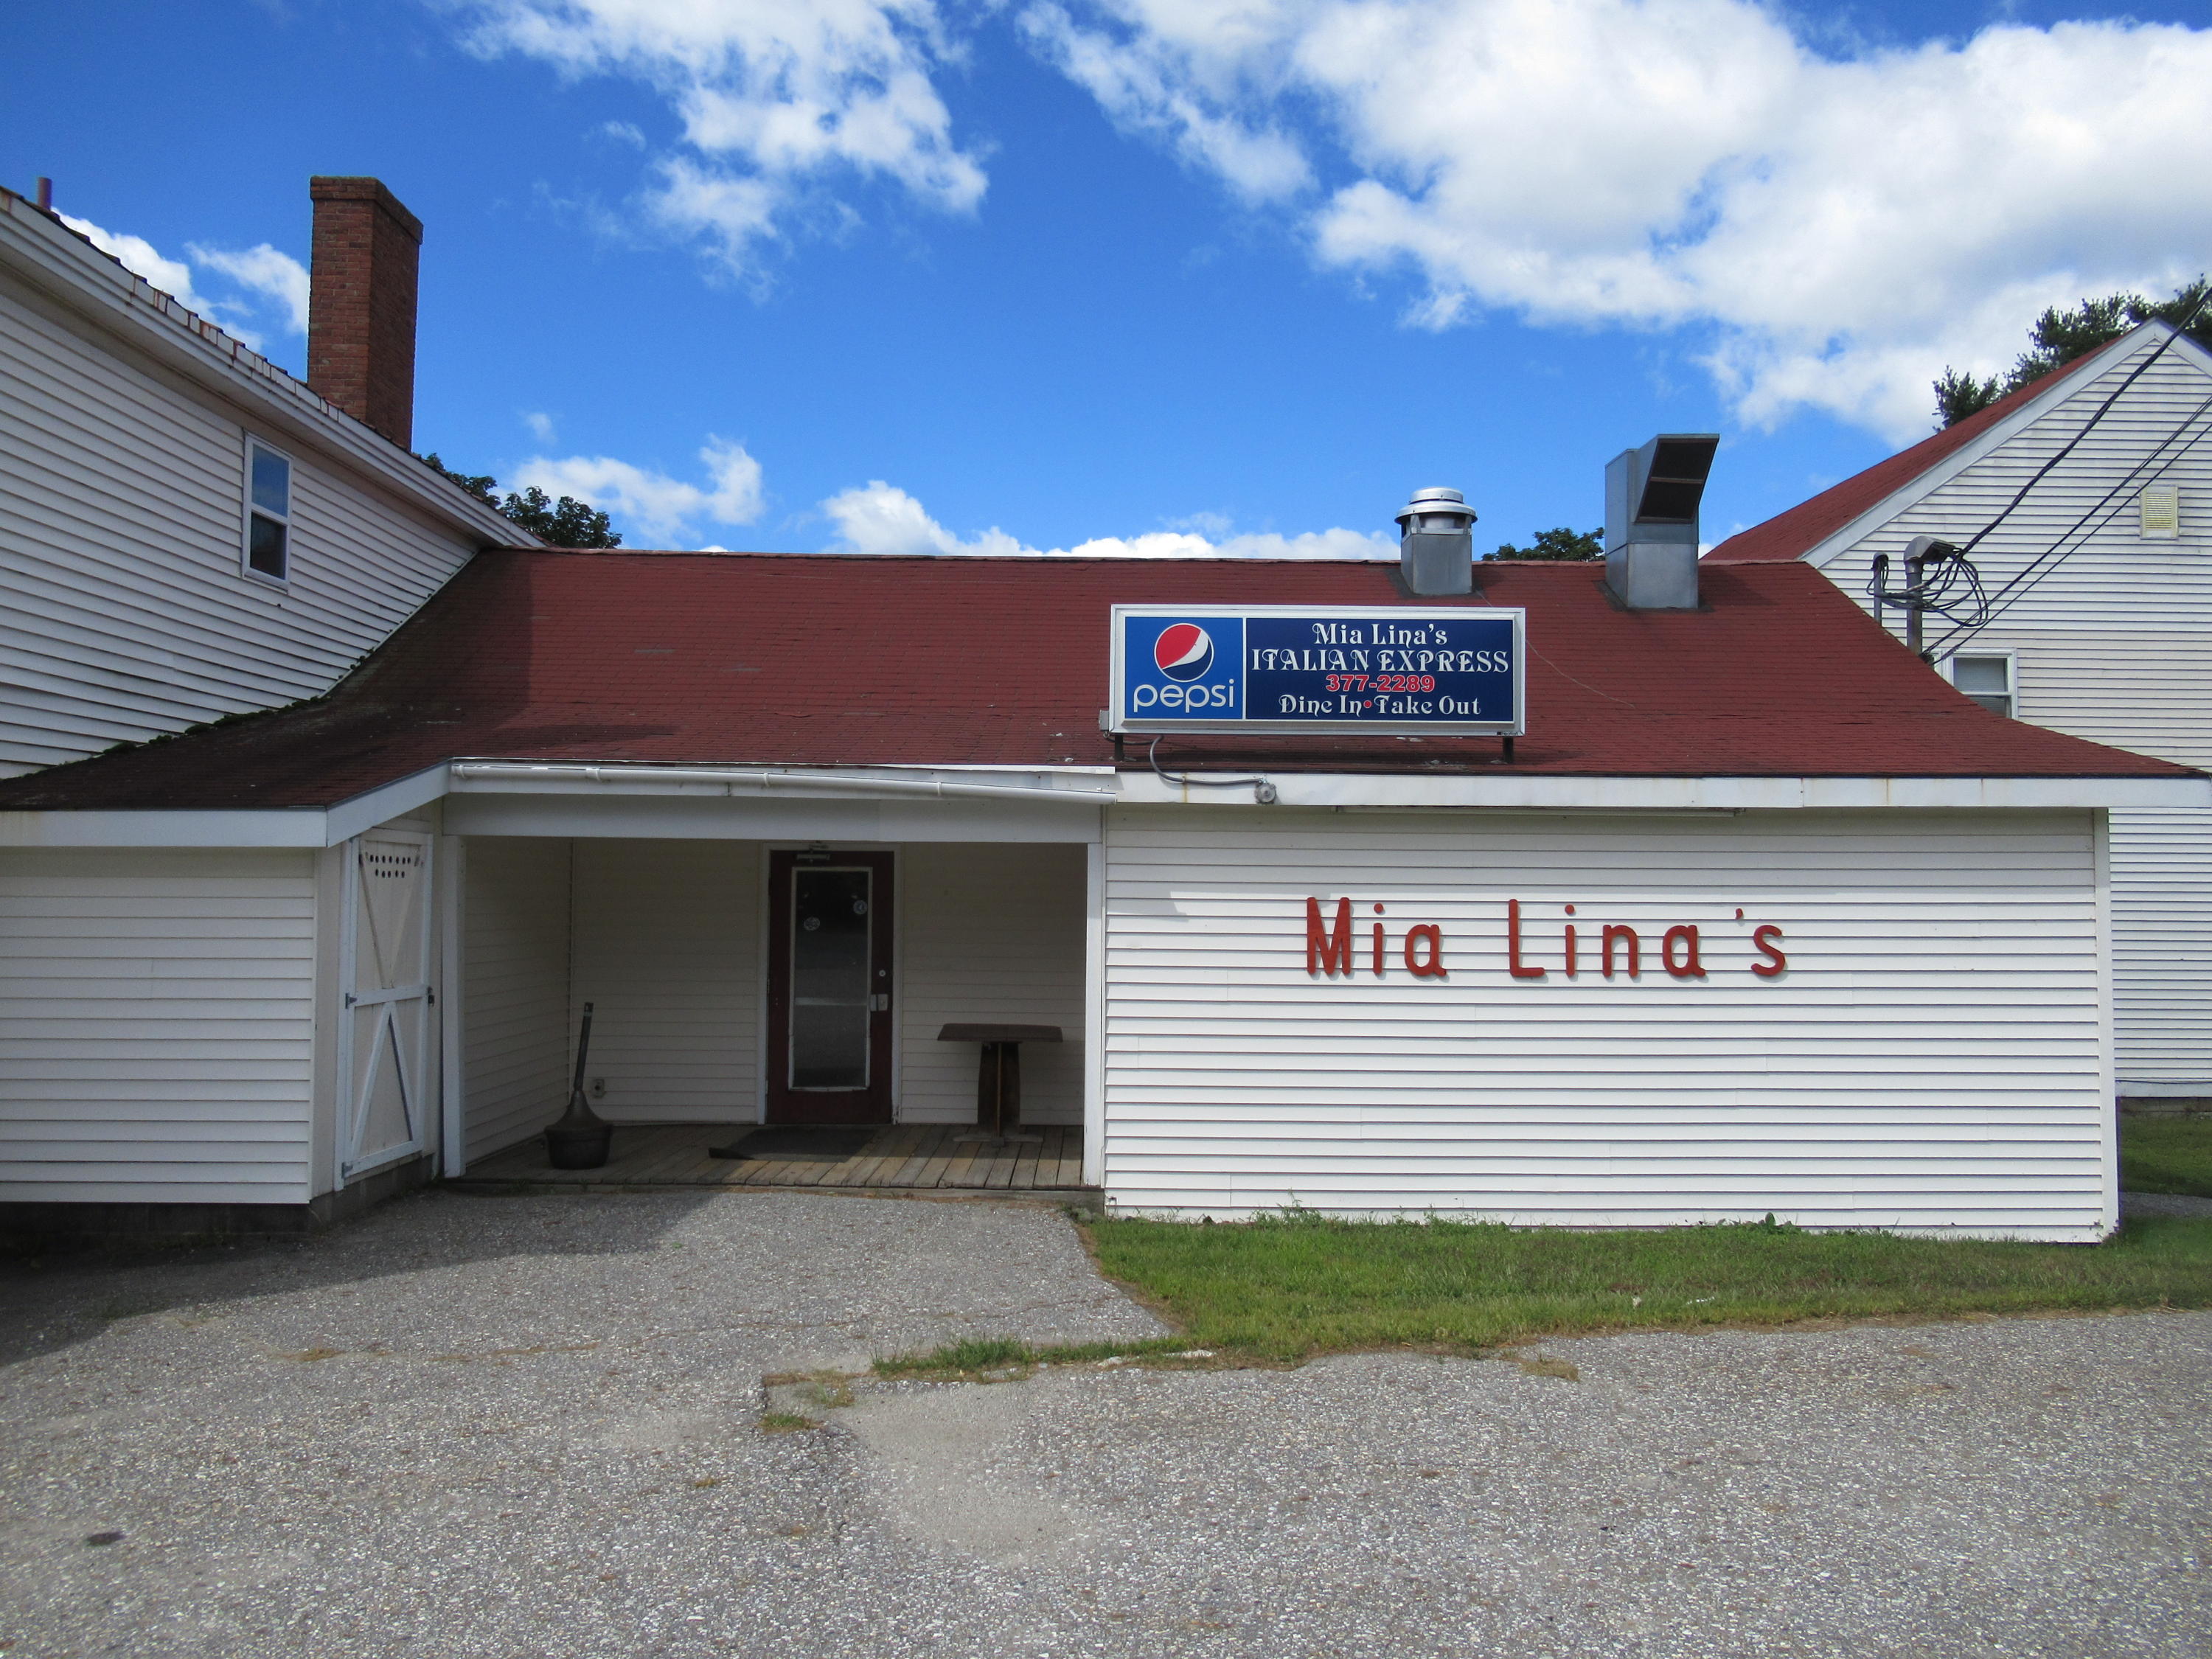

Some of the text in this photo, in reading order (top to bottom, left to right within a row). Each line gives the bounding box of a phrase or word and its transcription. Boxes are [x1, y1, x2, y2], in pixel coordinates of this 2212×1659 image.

[1312, 623, 1447, 649] Mia Lina's
[1251, 648, 1509, 673] ITALIAN EXPRESS
[1325, 674, 1435, 692] 377-2289
[1133, 678, 1234, 714] pepsi
[1279, 695, 1332, 717] Dine
[1439, 695, 1481, 714] Out
[1306, 897, 1787, 977] Mia Lina's
